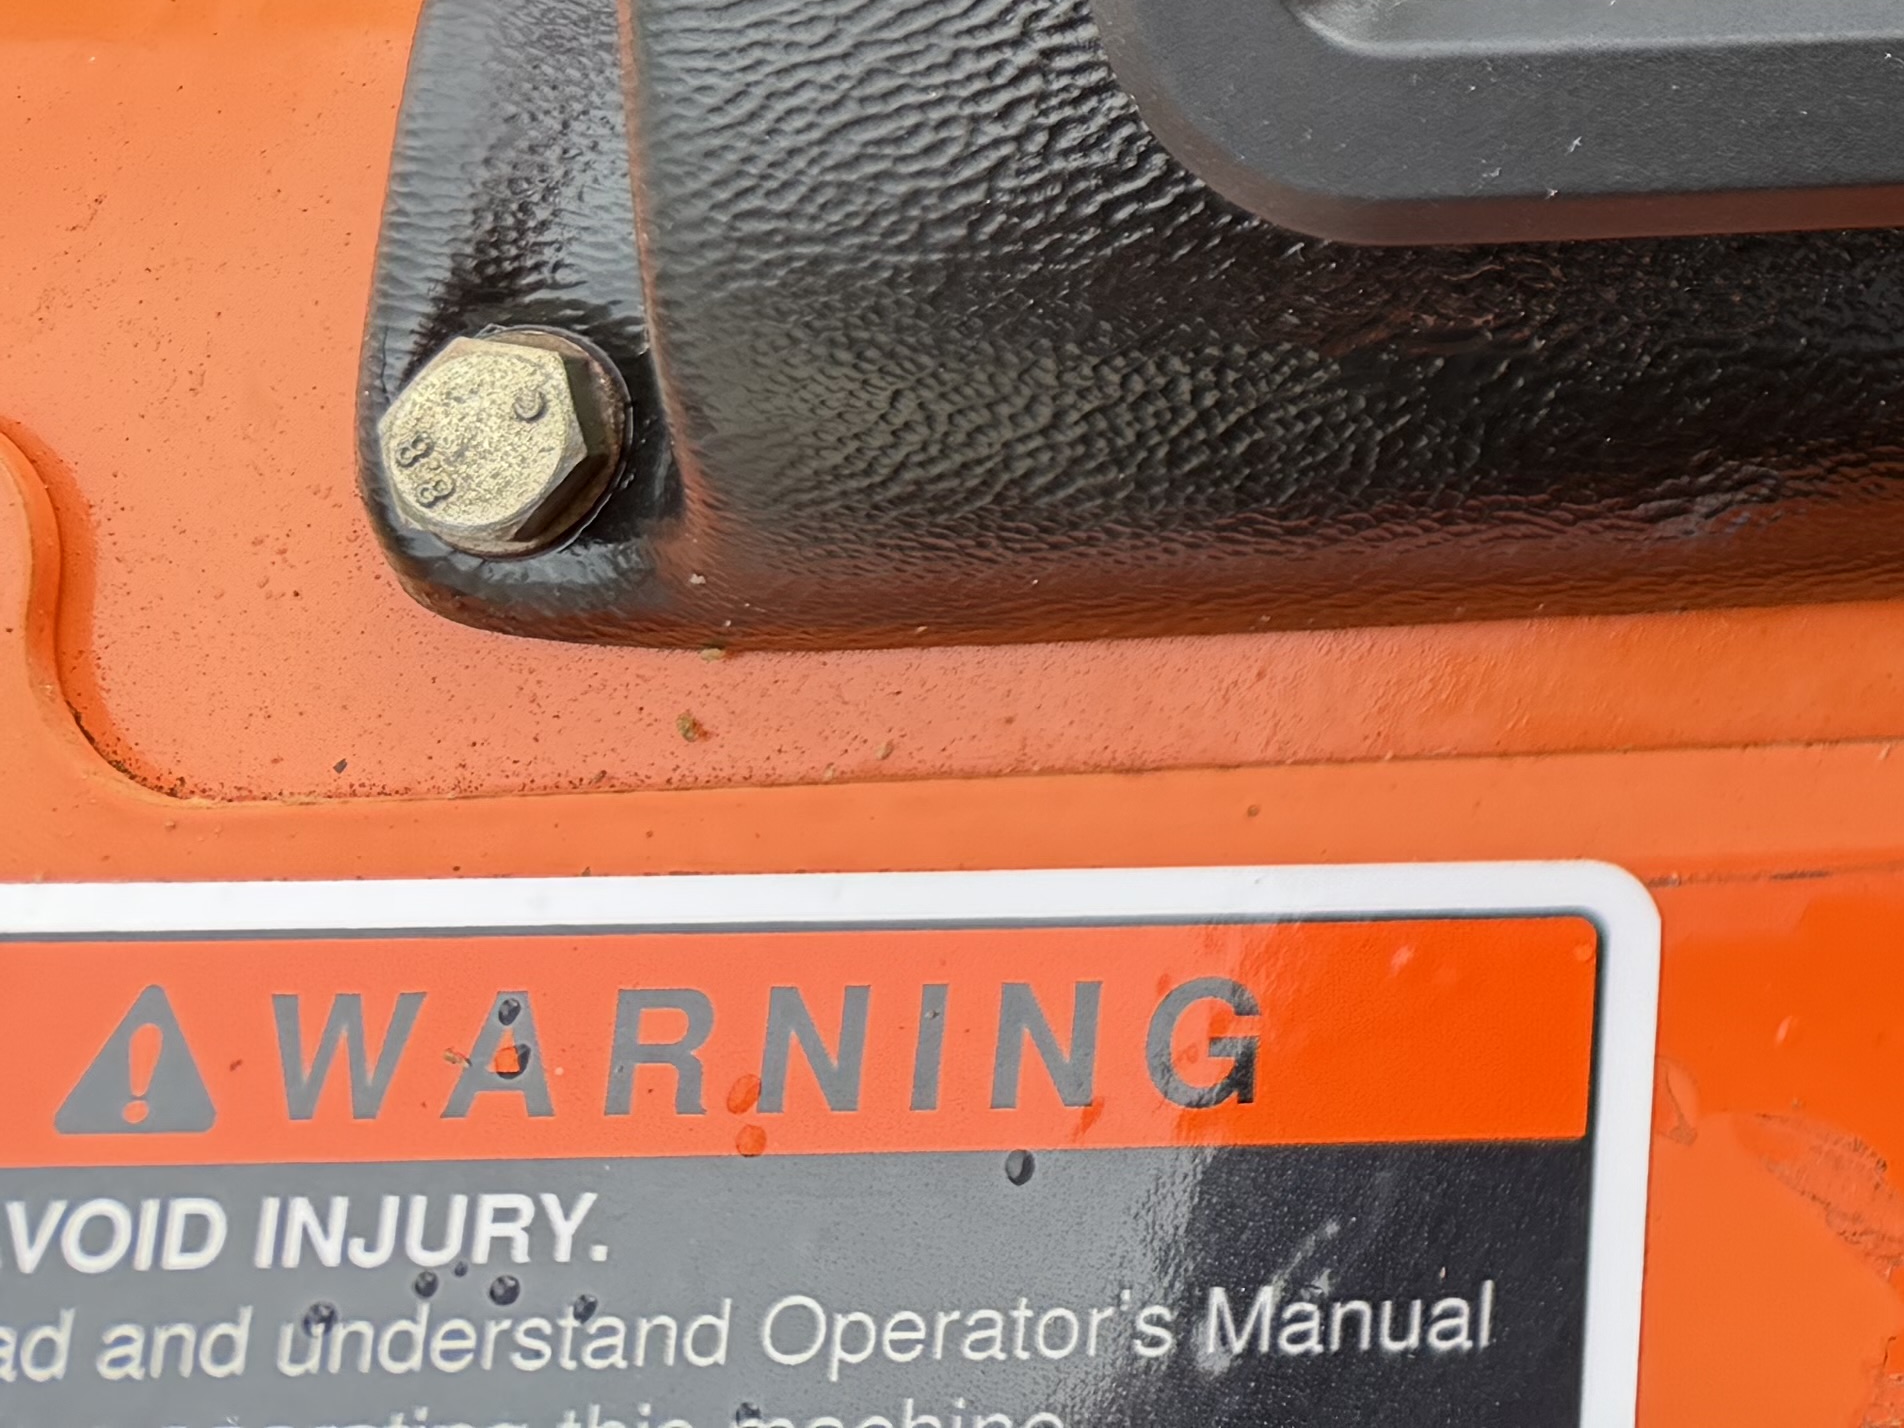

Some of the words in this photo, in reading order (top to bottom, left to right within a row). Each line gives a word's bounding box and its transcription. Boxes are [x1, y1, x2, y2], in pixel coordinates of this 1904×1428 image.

[271, 975, 1262, 1121] WARNING
[0, 1196, 228, 1274] VOID
[253, 1191, 609, 1269] INJURY.
[96, 1304, 254, 1382] and
[276, 1297, 733, 1377] understand
[761, 1288, 1176, 1382] Operator's
[1202, 1279, 1497, 1356] Manual
